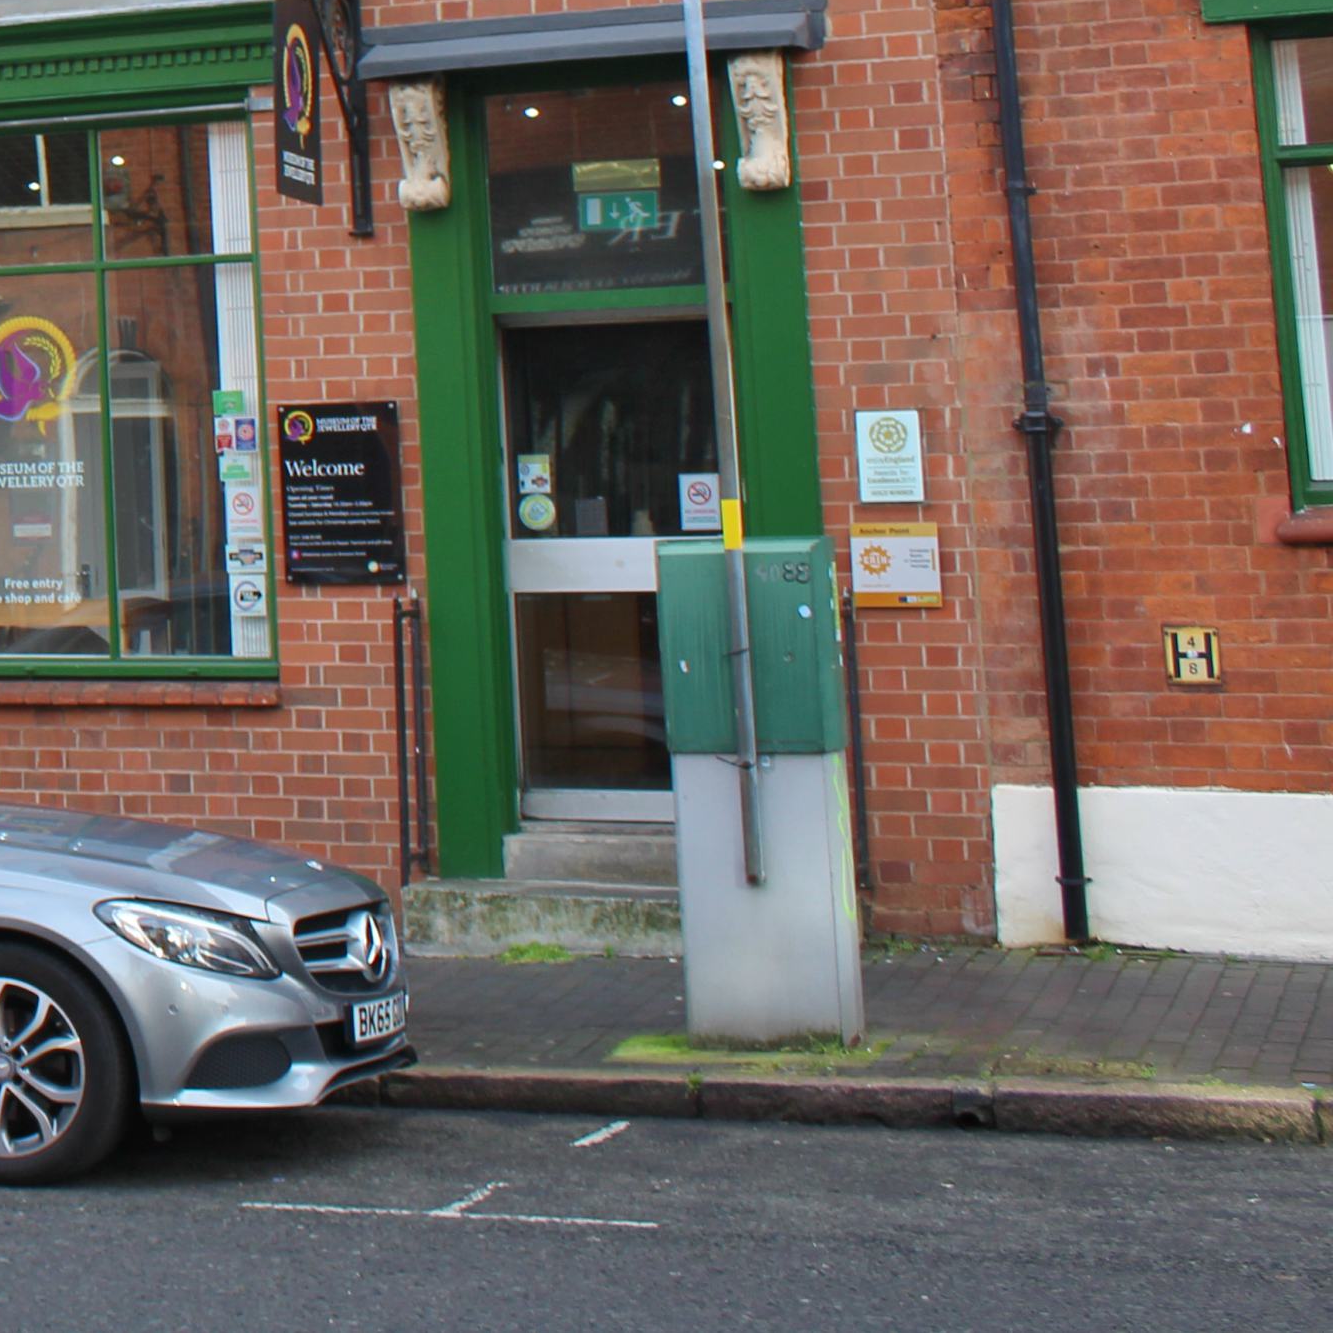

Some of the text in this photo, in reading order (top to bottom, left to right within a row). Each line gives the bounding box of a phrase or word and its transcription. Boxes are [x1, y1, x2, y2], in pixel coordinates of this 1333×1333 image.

[38, 461, 55, 475] OF
[57, 461, 85, 474] THE
[284, 458, 365, 478] Welcome
[56, 474, 85, 489] QTR
[4, 577, 63, 591] Free entry
[5, 593, 32, 606] shop
[34, 592, 55, 604] and
[1187, 636, 1196, 648] 4
[1170, 632, 1215, 679] H
[359, 1001, 391, 1037] BK65
